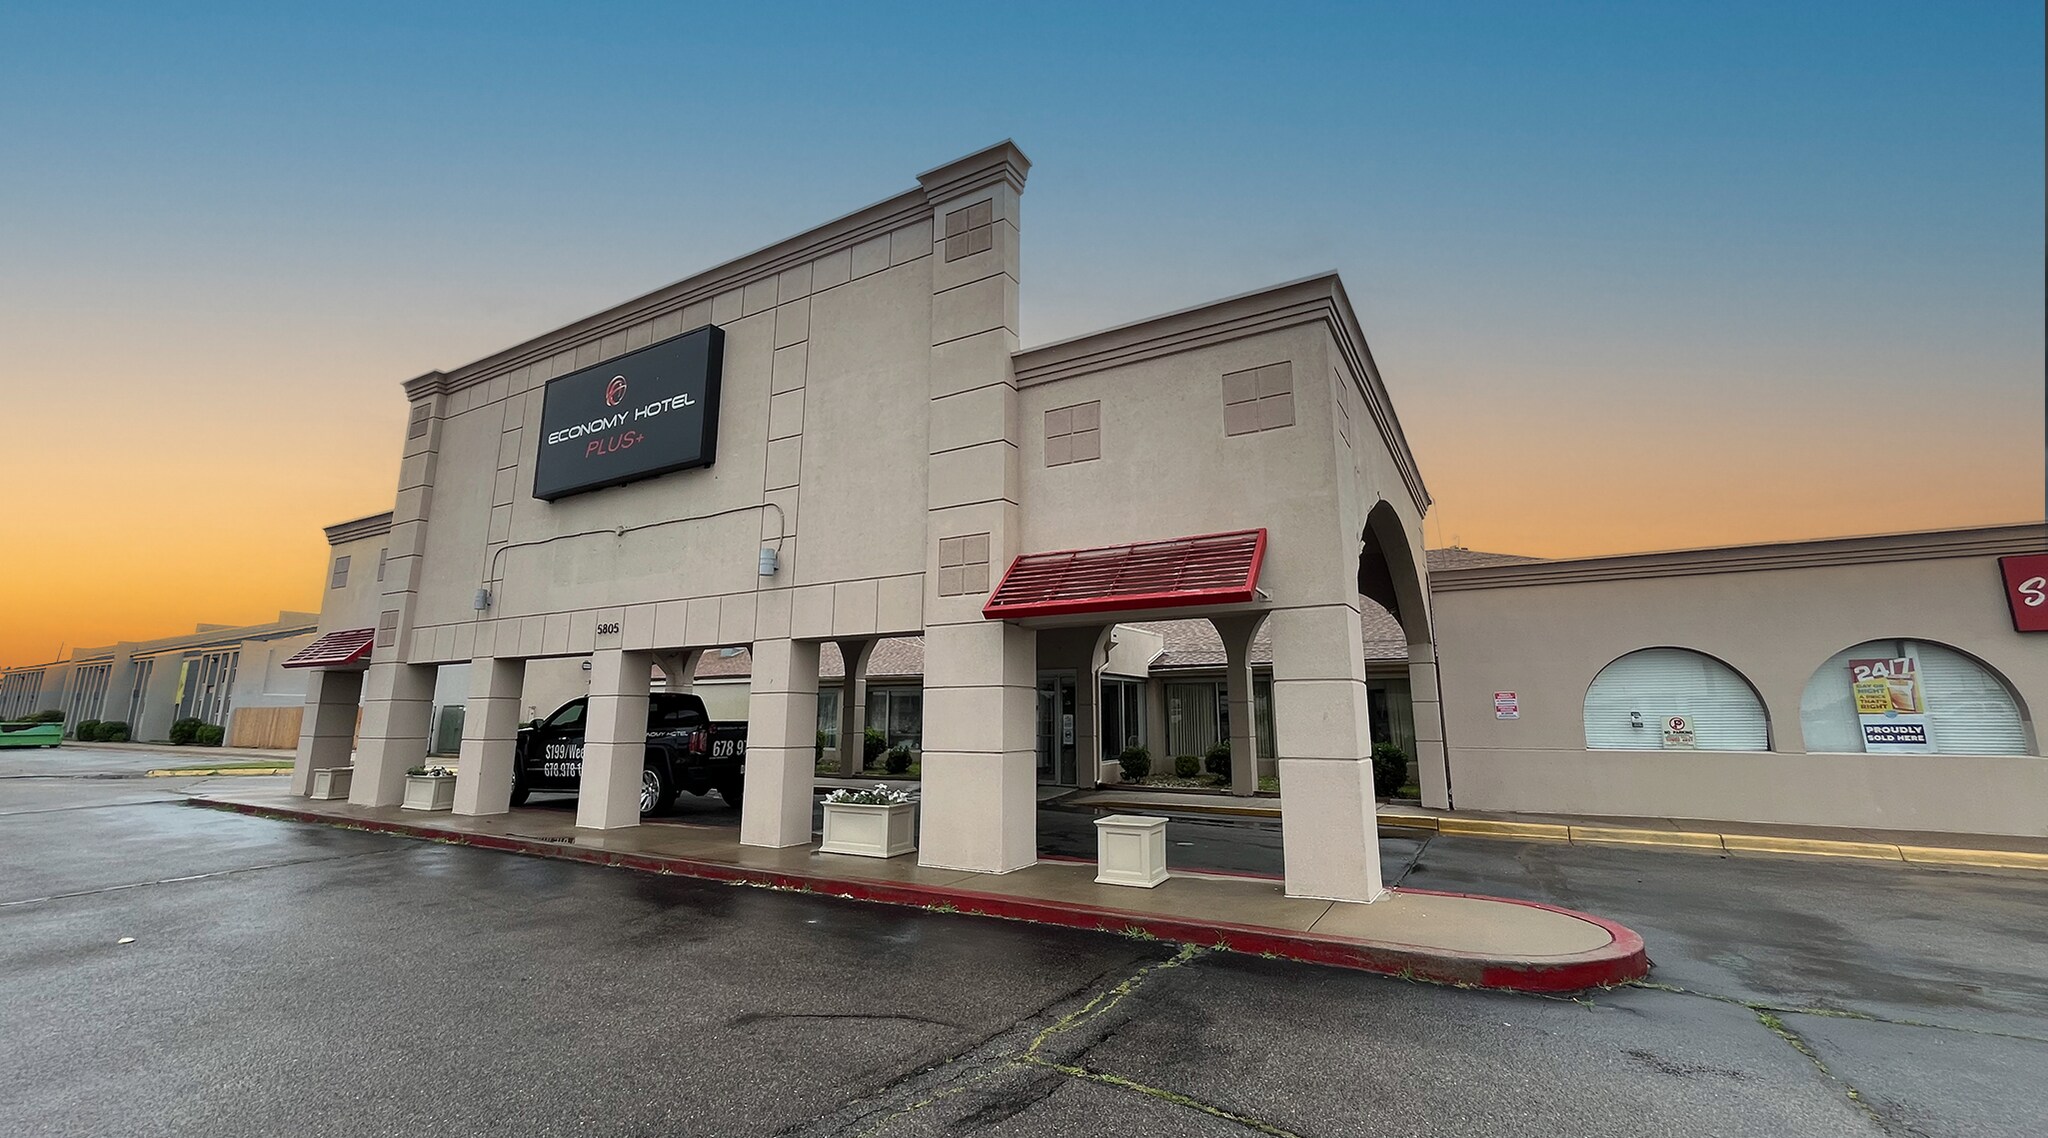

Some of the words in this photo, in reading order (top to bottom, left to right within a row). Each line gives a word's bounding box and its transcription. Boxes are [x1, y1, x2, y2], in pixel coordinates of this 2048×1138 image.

[548, 411, 629, 445] ECONOMY
[634, 393, 696, 421] HOTEL
[585, 430, 645, 459] PLUS+
[597, 622, 620, 635] 5805
[1865, 726, 1922, 734] PROUDLY
[545, 744, 585, 760] $199/Wee
[713, 740, 734, 757] 678
